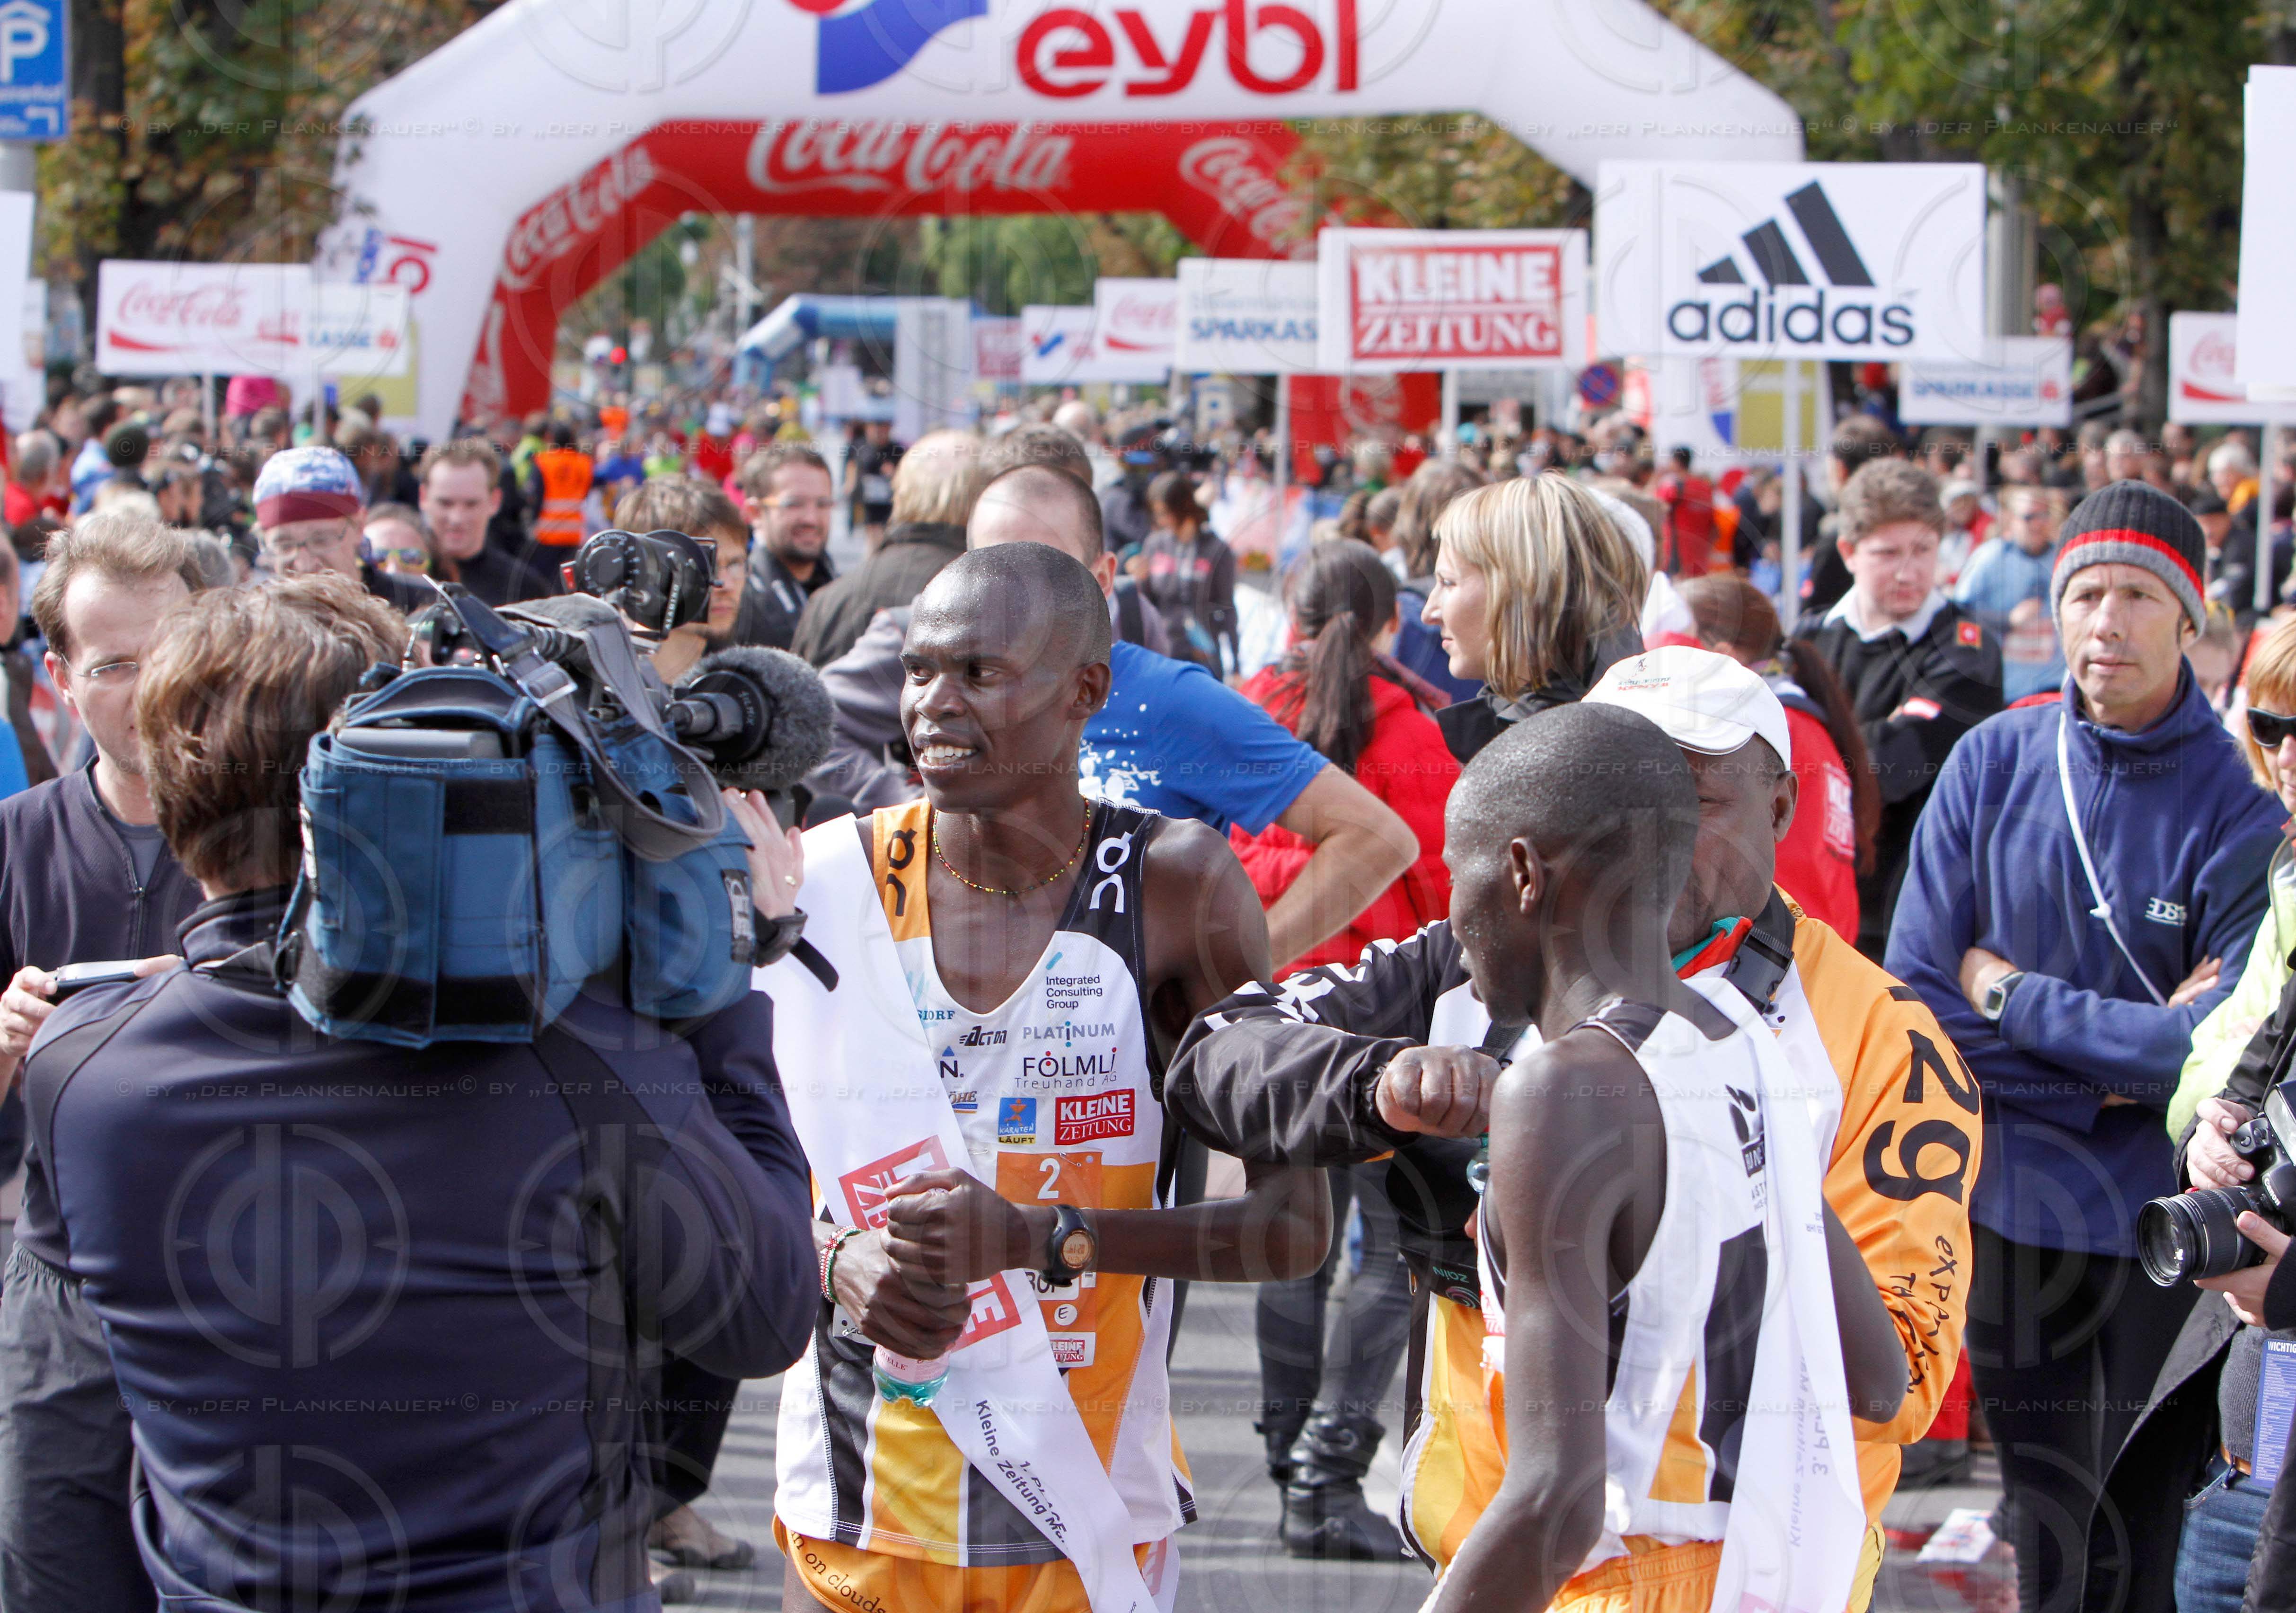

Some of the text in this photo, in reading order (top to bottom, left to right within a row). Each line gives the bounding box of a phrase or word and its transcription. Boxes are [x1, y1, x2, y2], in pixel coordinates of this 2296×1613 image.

[1016, 0, 1358, 98] eybl
[1354, 250, 1554, 304] KLEINE
[1667, 287, 1915, 345] adidas
[1358, 311, 1559, 353] ZEITUNG
[1046, 975, 1100, 986] Integrated
[1046, 987, 1103, 997] Consulting
[1047, 1000, 1079, 1010] Group
[1015, 1076, 1095, 1089] Treuhand
[1060, 1094, 1130, 1121] KLEINE
[1060, 1118, 1131, 1141] ZEITUNG
[1037, 1158, 1060, 1199] 2
[2264, 1178, 2280, 1206] Canon
[1058, 1307, 1069, 1319] E
[976, 1400, 1065, 1543] Kleine Zeitung Ma
[805, 1553, 886, 1613] on clouds
